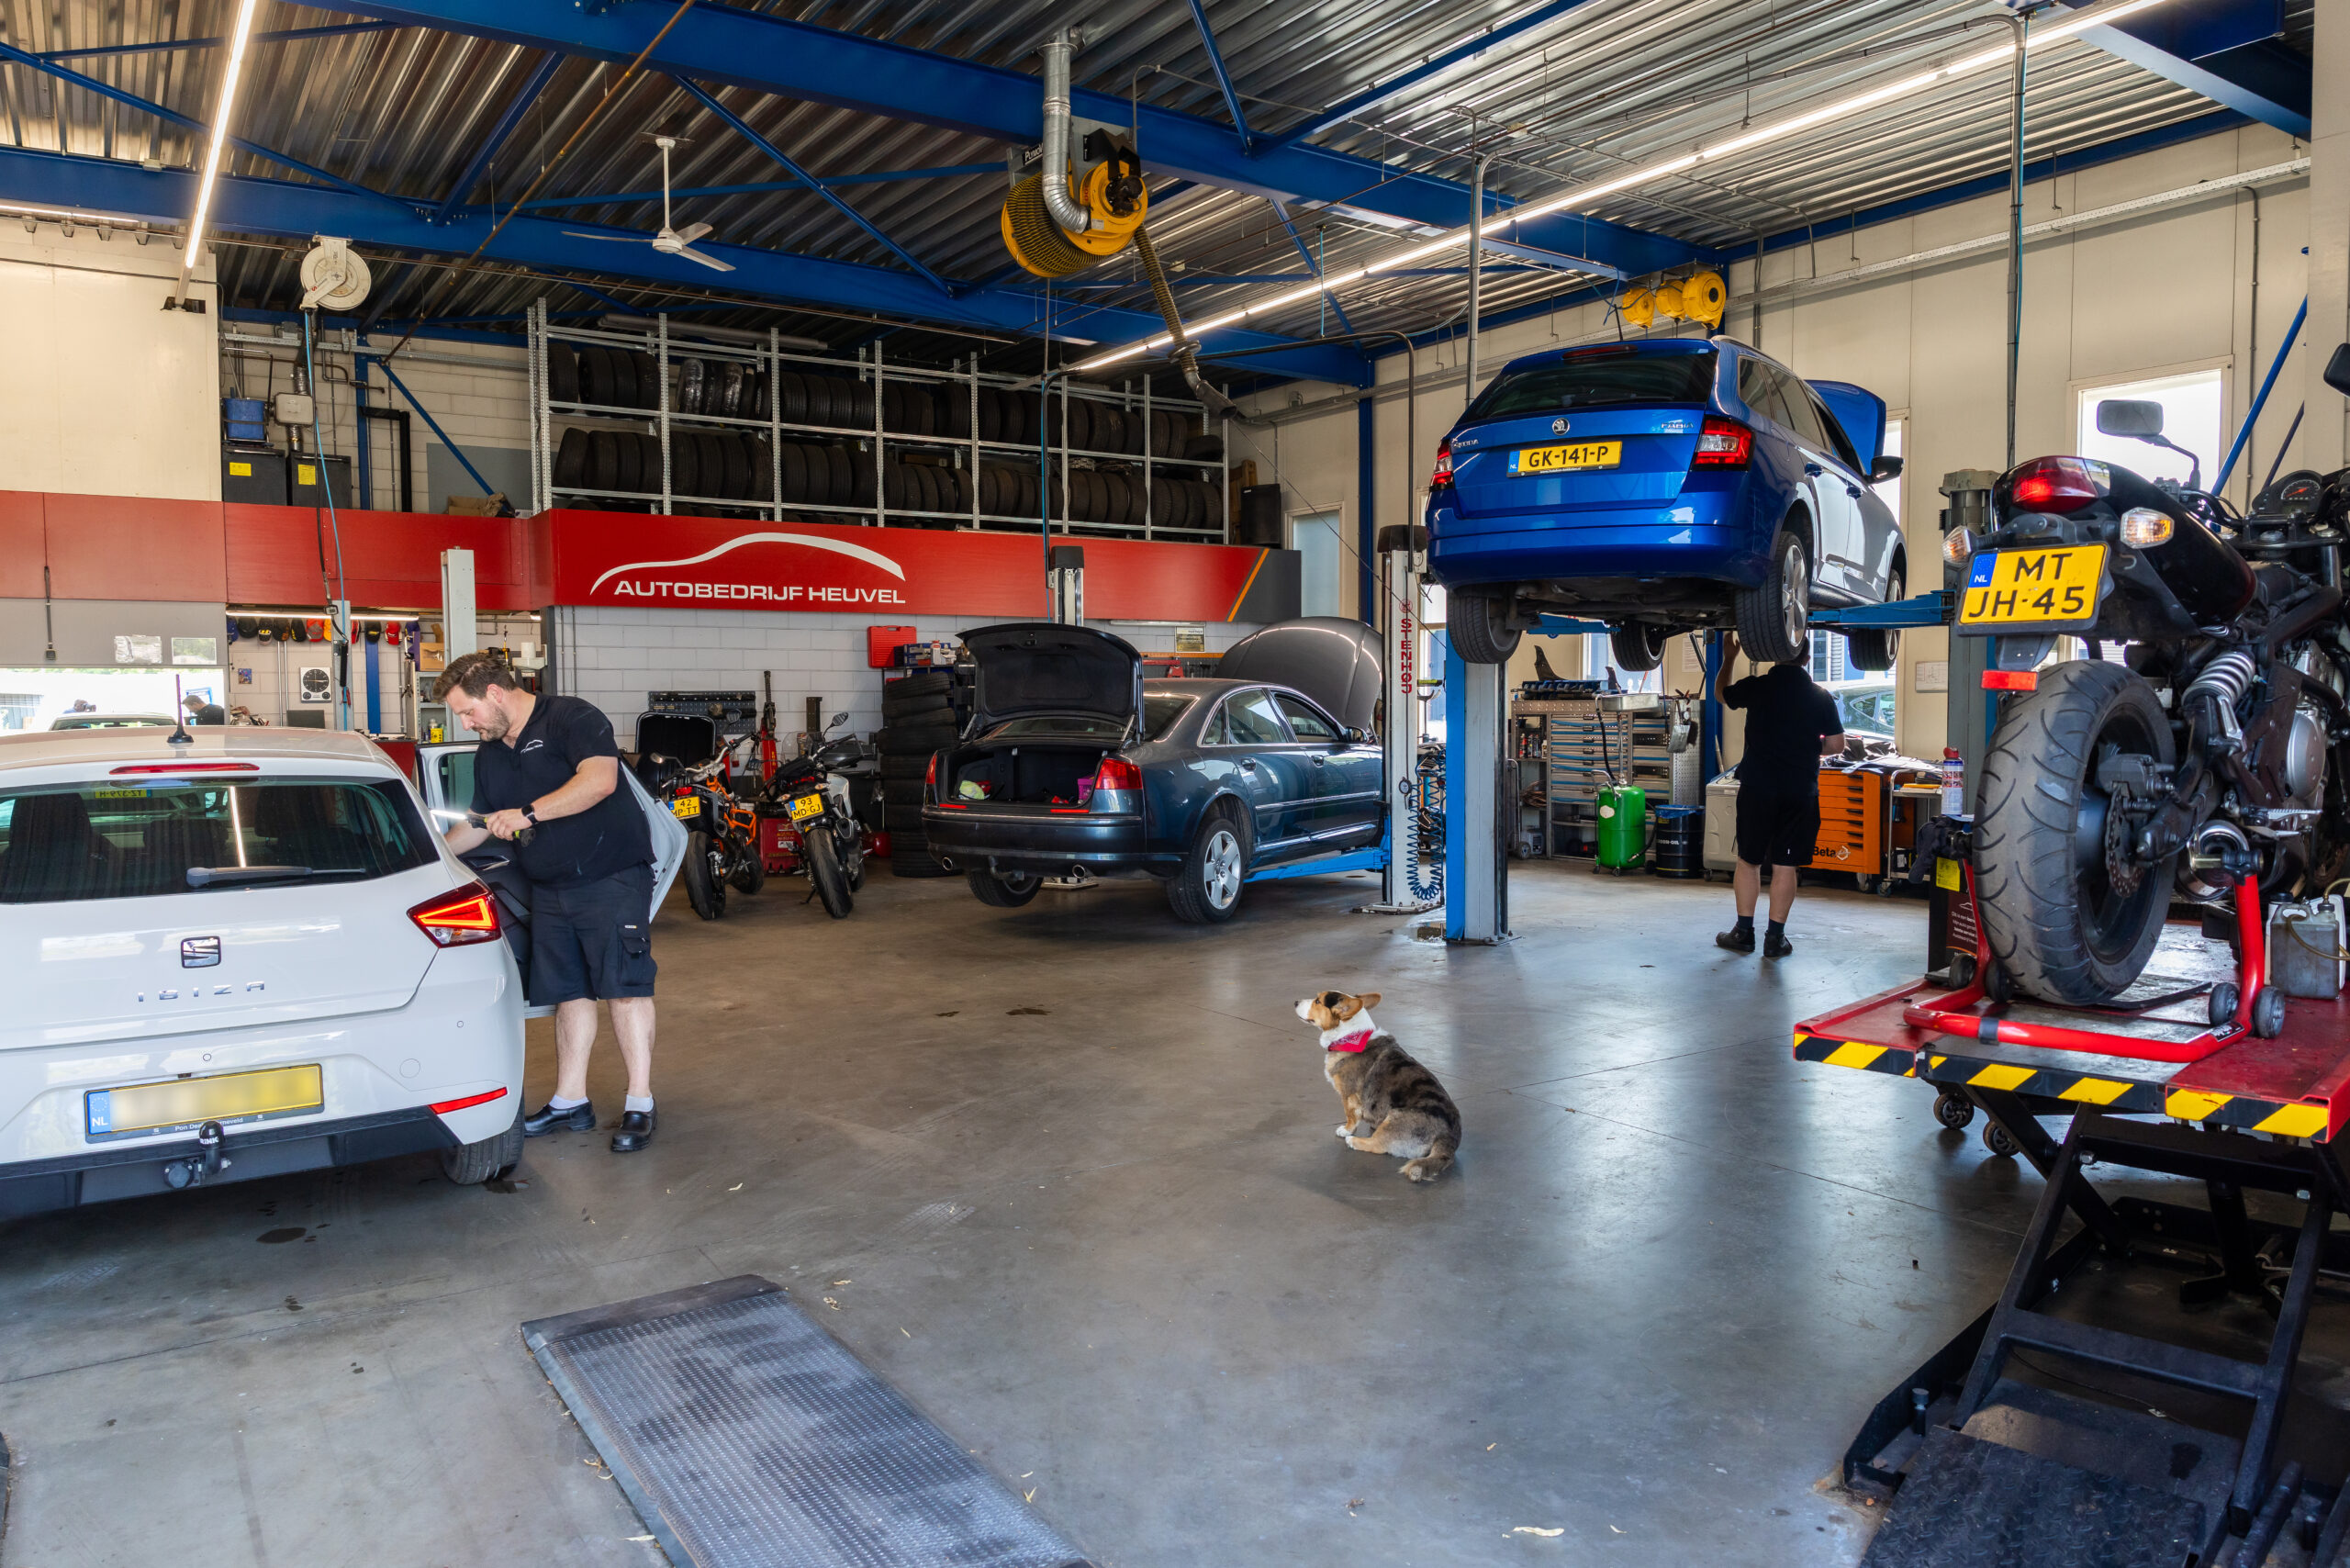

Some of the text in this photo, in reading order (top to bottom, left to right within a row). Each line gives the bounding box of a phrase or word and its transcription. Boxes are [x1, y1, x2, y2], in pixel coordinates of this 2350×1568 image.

[1024, 142, 1043, 162] PLYMOV
[1528, 445, 1609, 468] GK-141-P
[2014, 552, 2073, 583] MT
[1974, 574, 1987, 583] NL
[614, 580, 906, 604] AUTOBEDRIJF HEUVEL
[1968, 586, 2085, 619] JH-45
[800, 798, 812, 807] 93
[793, 803, 821, 819] MD-GJ
[1813, 846, 1836, 858] Beta
[138, 981, 264, 1002] IBIZA
[92, 1116, 108, 1126] NL
[219, 1117, 243, 1126] rneveld
[199, 1137, 219, 1145] RINK
